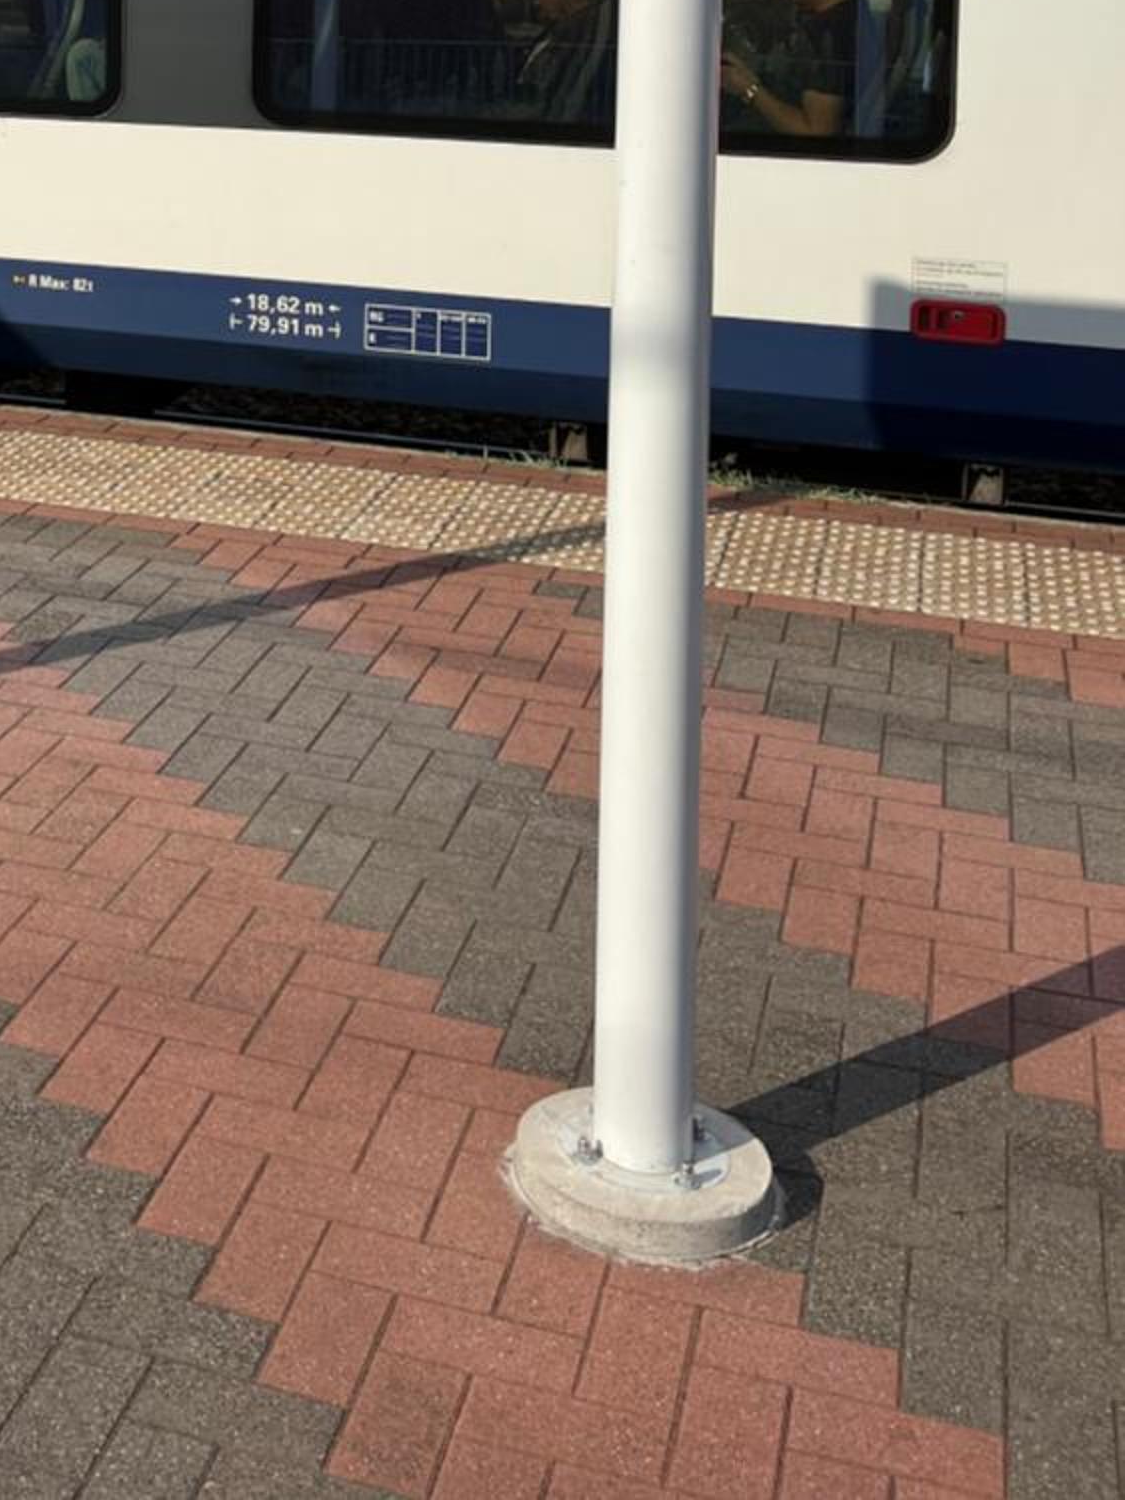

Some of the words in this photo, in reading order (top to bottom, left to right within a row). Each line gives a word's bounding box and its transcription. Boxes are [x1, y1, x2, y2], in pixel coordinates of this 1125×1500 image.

[248, 293, 301, 315] 18,62
[304, 302, 324, 316] m
[247, 314, 300, 336] 79,91
[304, 323, 324, 338] m
